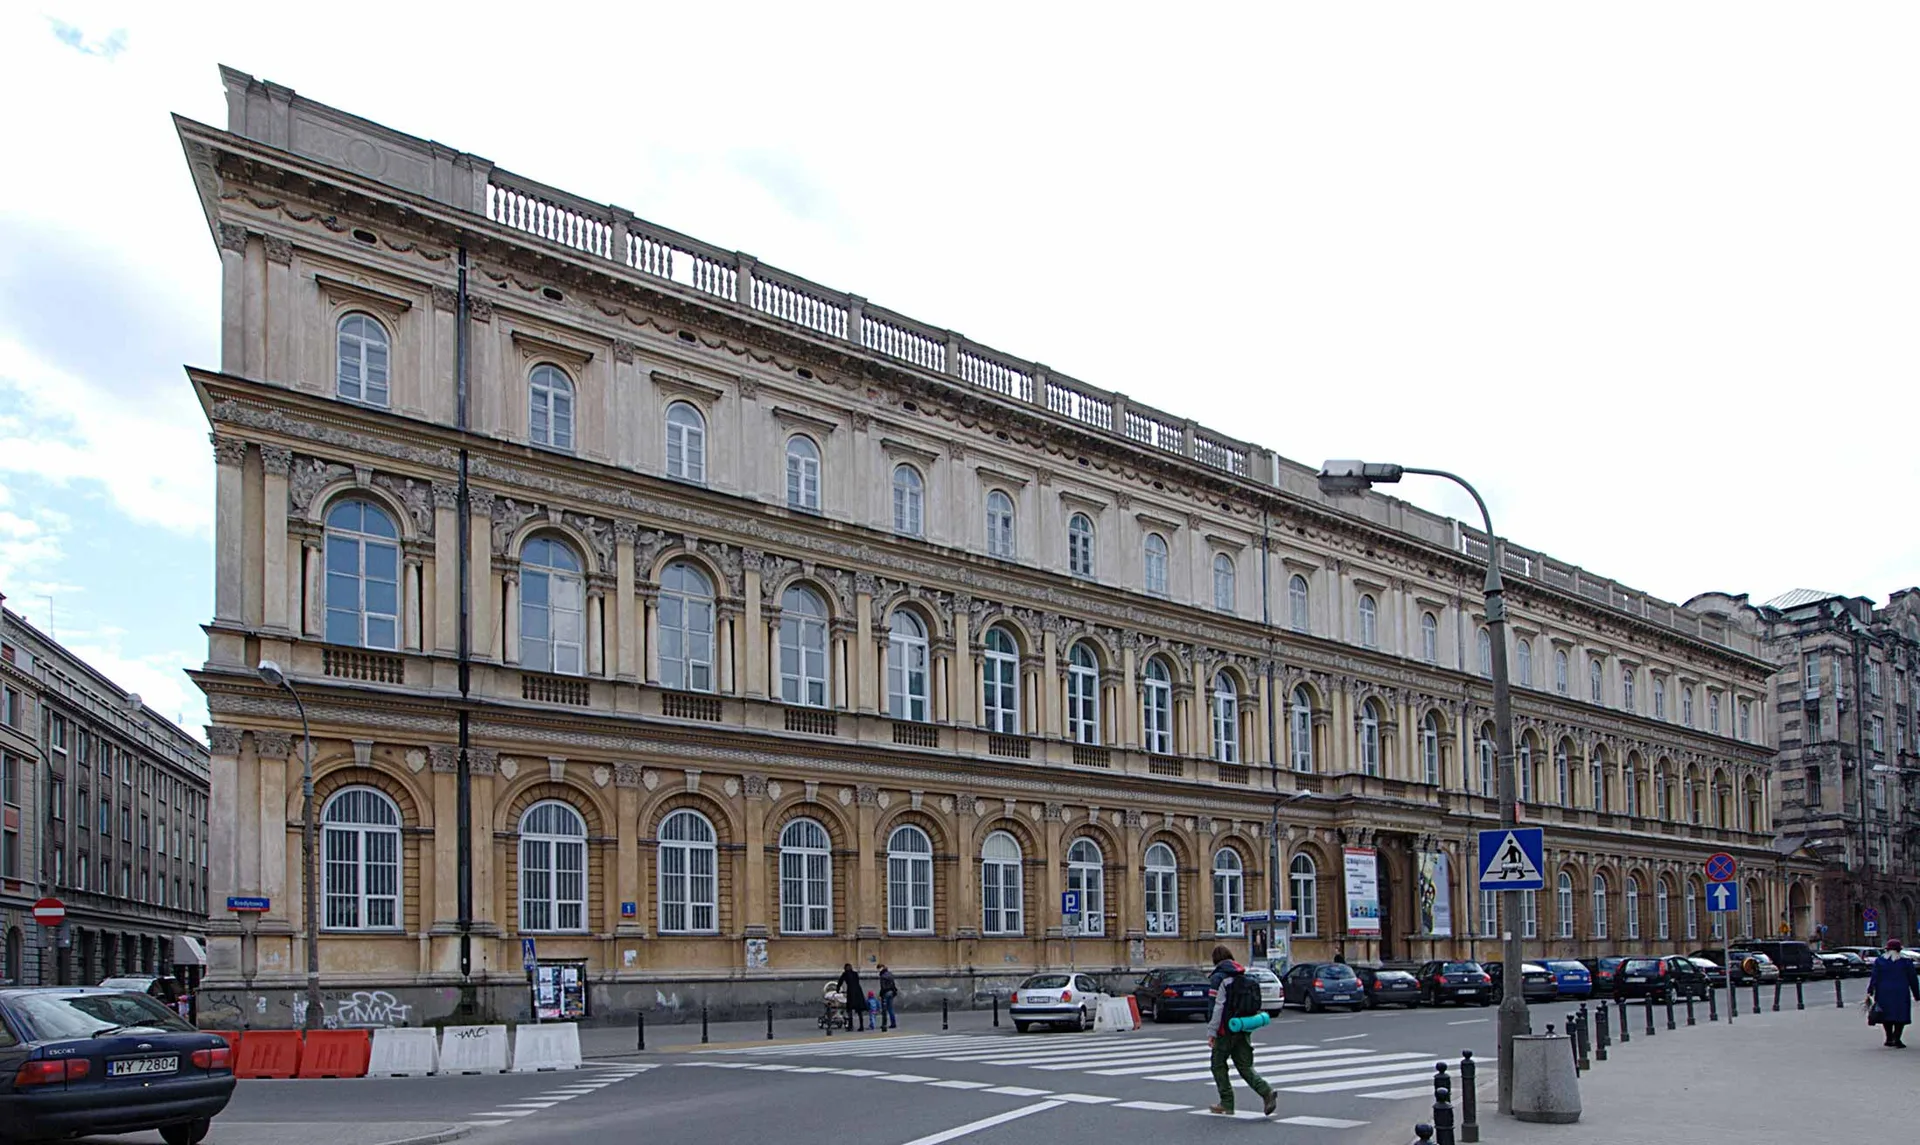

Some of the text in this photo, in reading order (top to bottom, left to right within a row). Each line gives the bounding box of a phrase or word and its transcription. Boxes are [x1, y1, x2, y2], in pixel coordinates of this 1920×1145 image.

[1866, 921, 1875, 931] P
[116, 1058, 176, 1074] WY 72804
